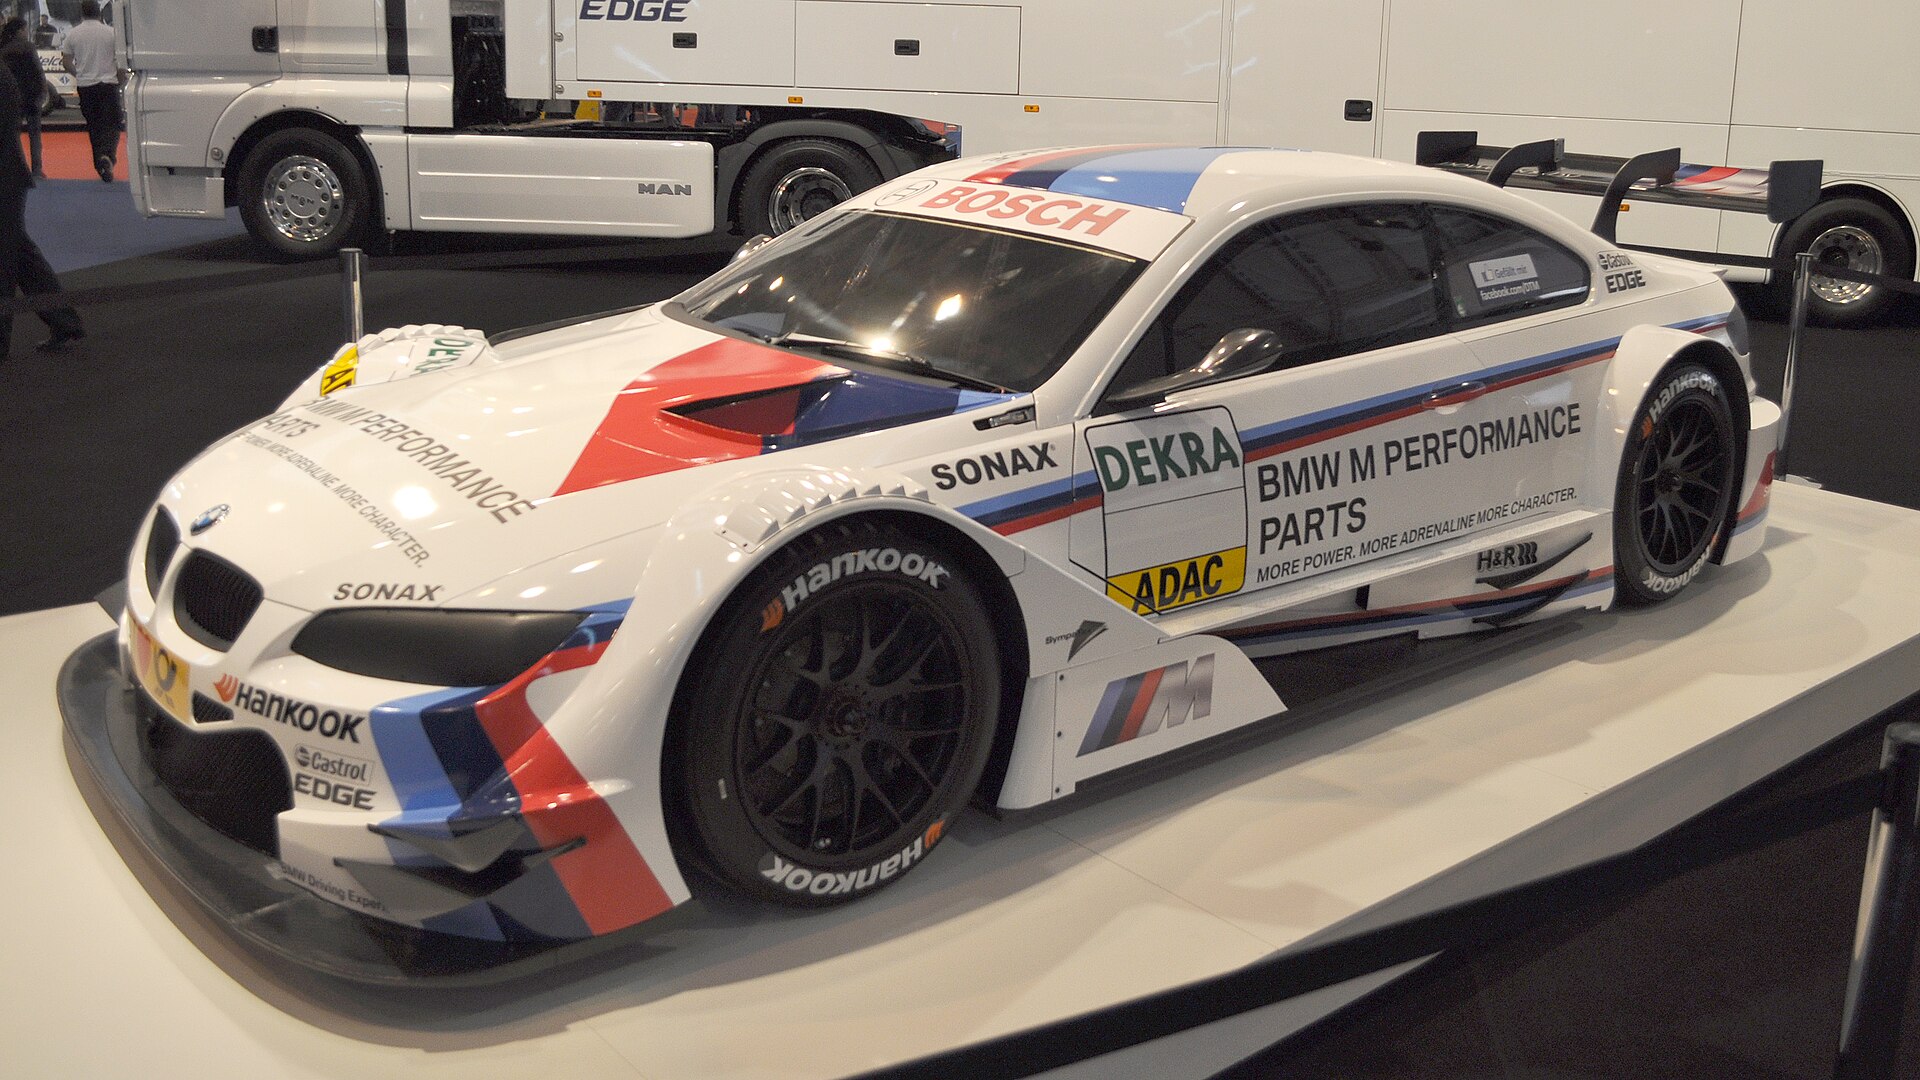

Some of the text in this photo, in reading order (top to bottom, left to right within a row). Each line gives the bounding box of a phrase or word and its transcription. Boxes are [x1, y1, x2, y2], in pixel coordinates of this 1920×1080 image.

[579, 0, 690, 23] EDGE
[637, 183, 692, 196] MAN
[918, 186, 1131, 236] BOSCH
[1605, 270, 1646, 294] EDGE
[348, 413, 537, 525] PERFORMANCE
[931, 441, 1058, 491] SONAX
[1094, 426, 1240, 493] DEKRA
[1257, 402, 1581, 503] BMW M PERFORMANCE
[332, 483, 369, 510] MORE
[358, 504, 430, 569] CHARACTER.
[1256, 487, 1577, 584] MORE POWER. MORE ADRENALINE MORE CHARACTER.
[1259, 496, 1367, 556] PARTS
[1131, 554, 1224, 613] ADAC
[1477, 545, 1516, 572] H&R
[333, 583, 442, 601] SONAX
[311, 750, 368, 782] Castrol
[294, 773, 378, 811] EDGE
